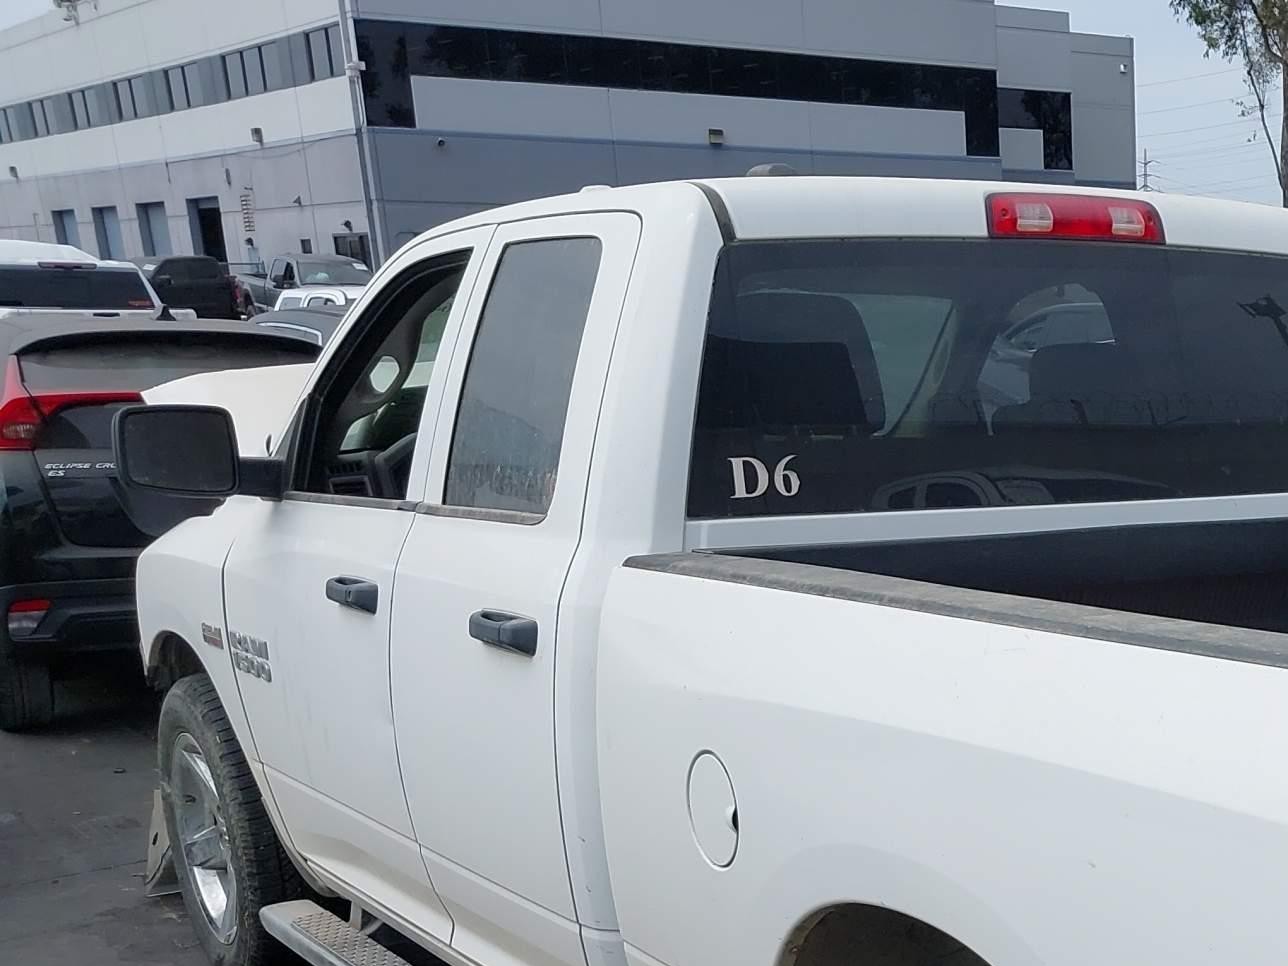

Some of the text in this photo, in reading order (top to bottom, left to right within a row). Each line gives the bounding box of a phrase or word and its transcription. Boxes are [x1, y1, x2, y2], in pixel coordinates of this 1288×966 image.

[727, 454, 801, 498] D6
[229, 631, 269, 661] RAM
[232, 651, 273, 683] 1500
